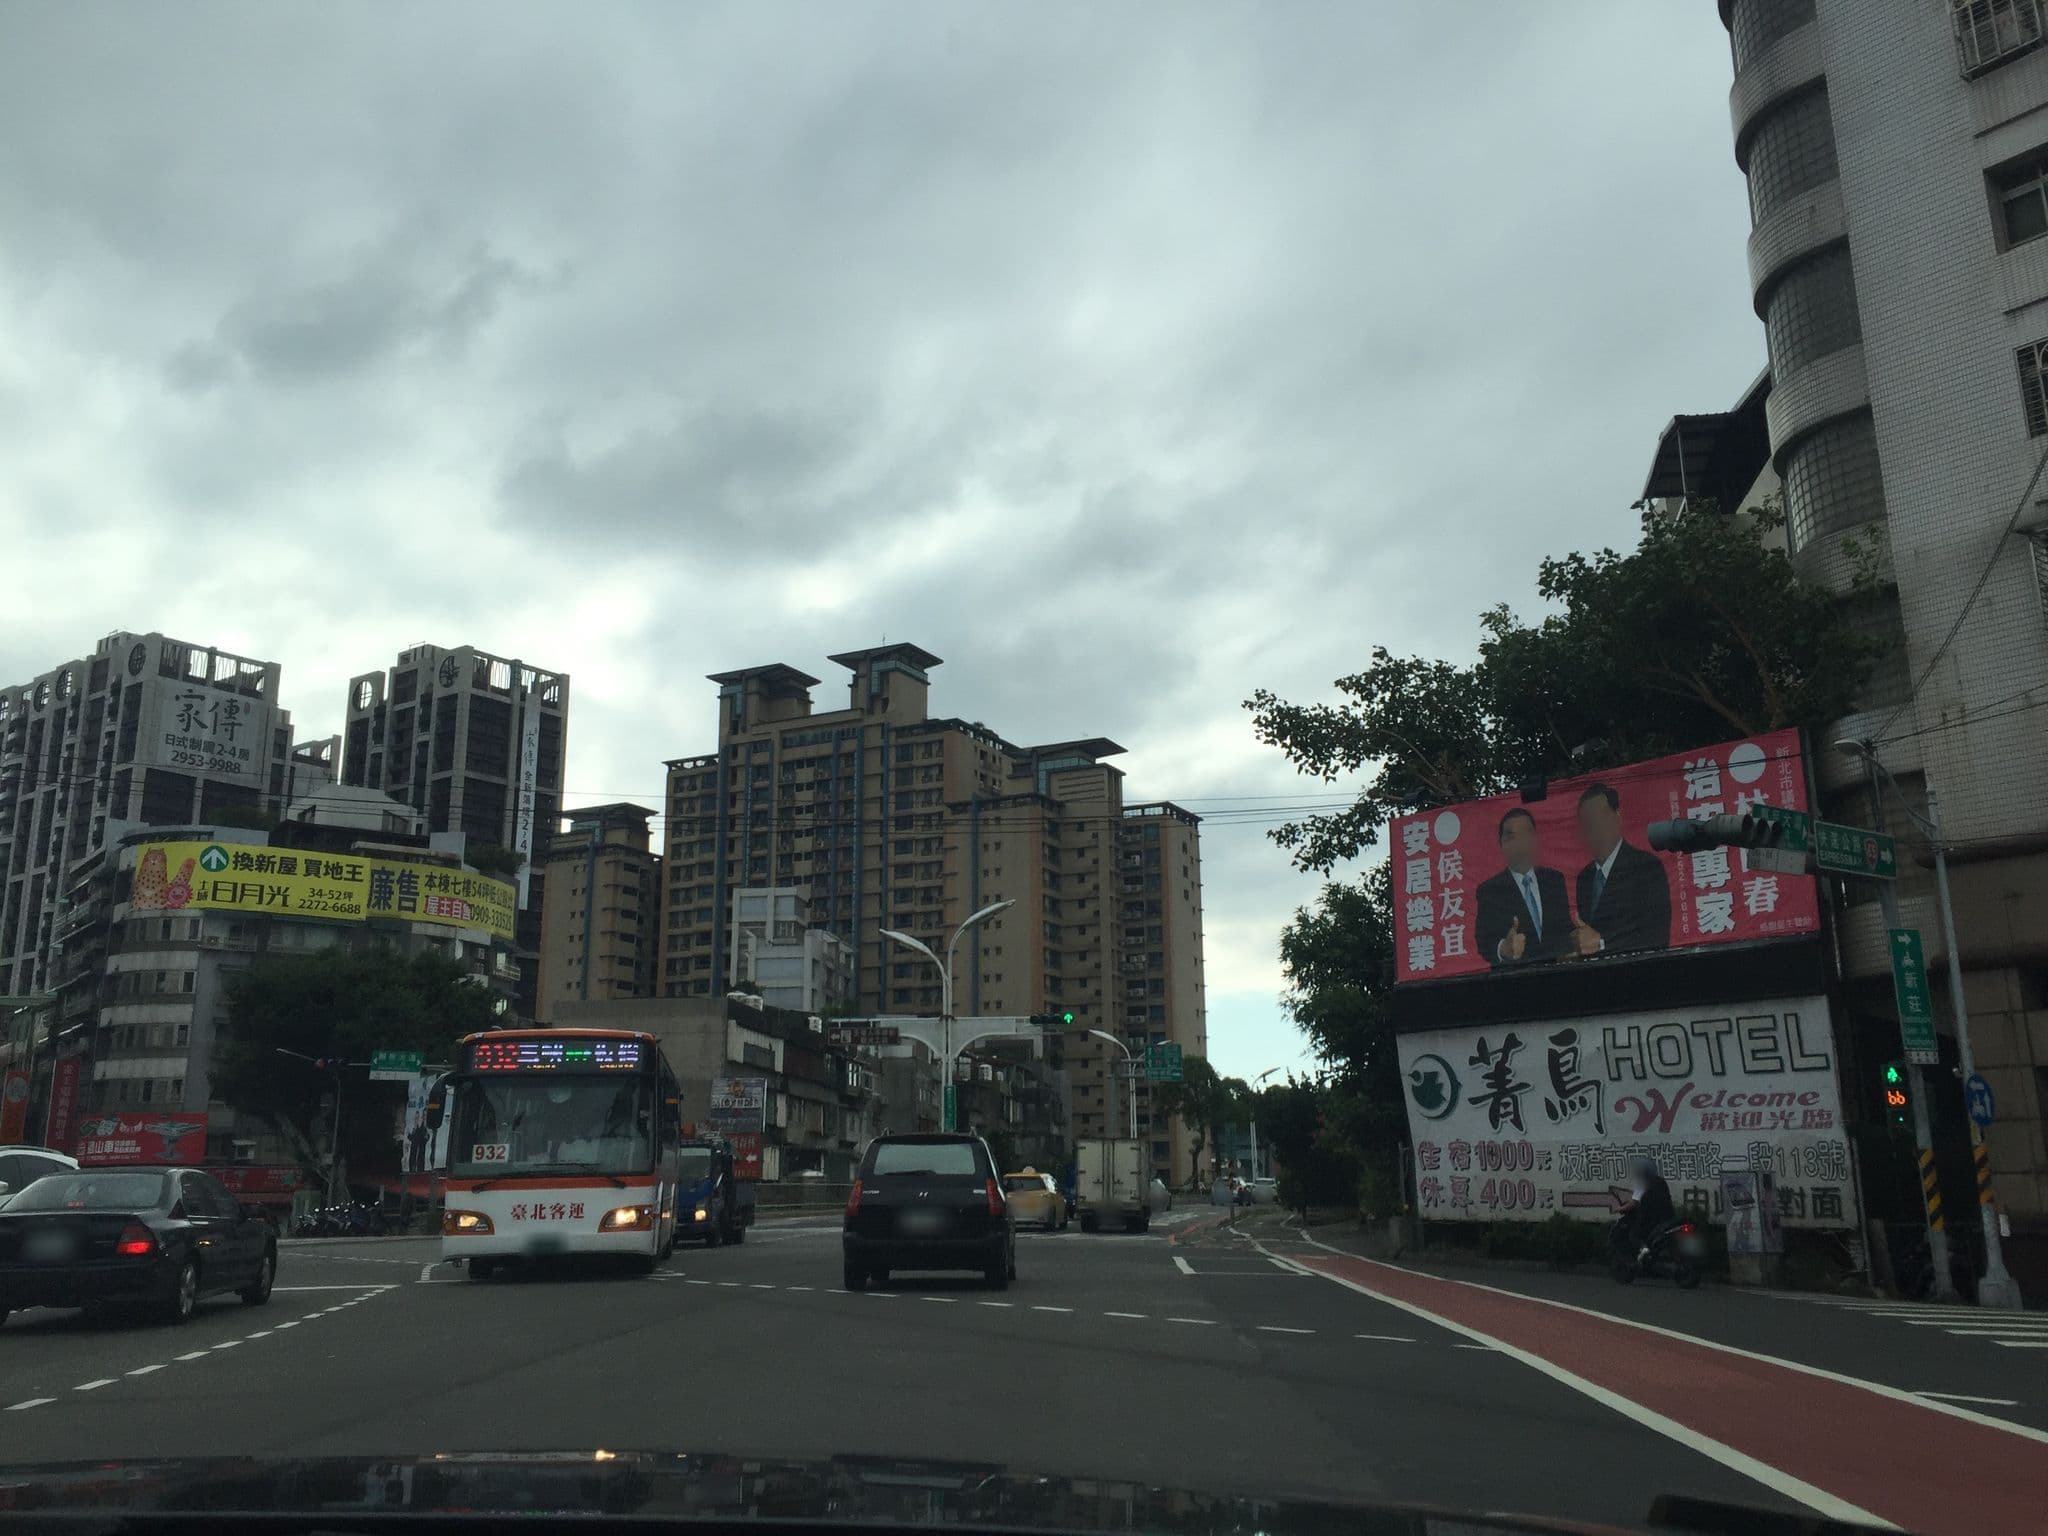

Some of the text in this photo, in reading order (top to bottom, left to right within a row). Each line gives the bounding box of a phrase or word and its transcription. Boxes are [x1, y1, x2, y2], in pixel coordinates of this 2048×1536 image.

[175, 689, 243, 741] 家傳
[171, 750, 241, 774] 2953-9988
[232, 851, 365, 883] 換新屋 買地王
[1734, 788, 1780, 916] 林春
[211, 881, 291, 908] 日月光
[308, 887, 354, 902] 34-52坪
[299, 898, 361, 915] 2272-6688
[368, 866, 420, 913] 廉售
[1402, 820, 1436, 973] 安居樂業
[1437, 849, 1468, 957] 侯友宜
[1603, 1013, 1831, 1081] HOTEL
[1614, 1082, 1820, 1134] Welcome
[1700, 1109, 1834, 1132] 歡迎光臨
[475, 1145, 506, 1160] 932
[510, 1202, 585, 1220] 臺北客運
